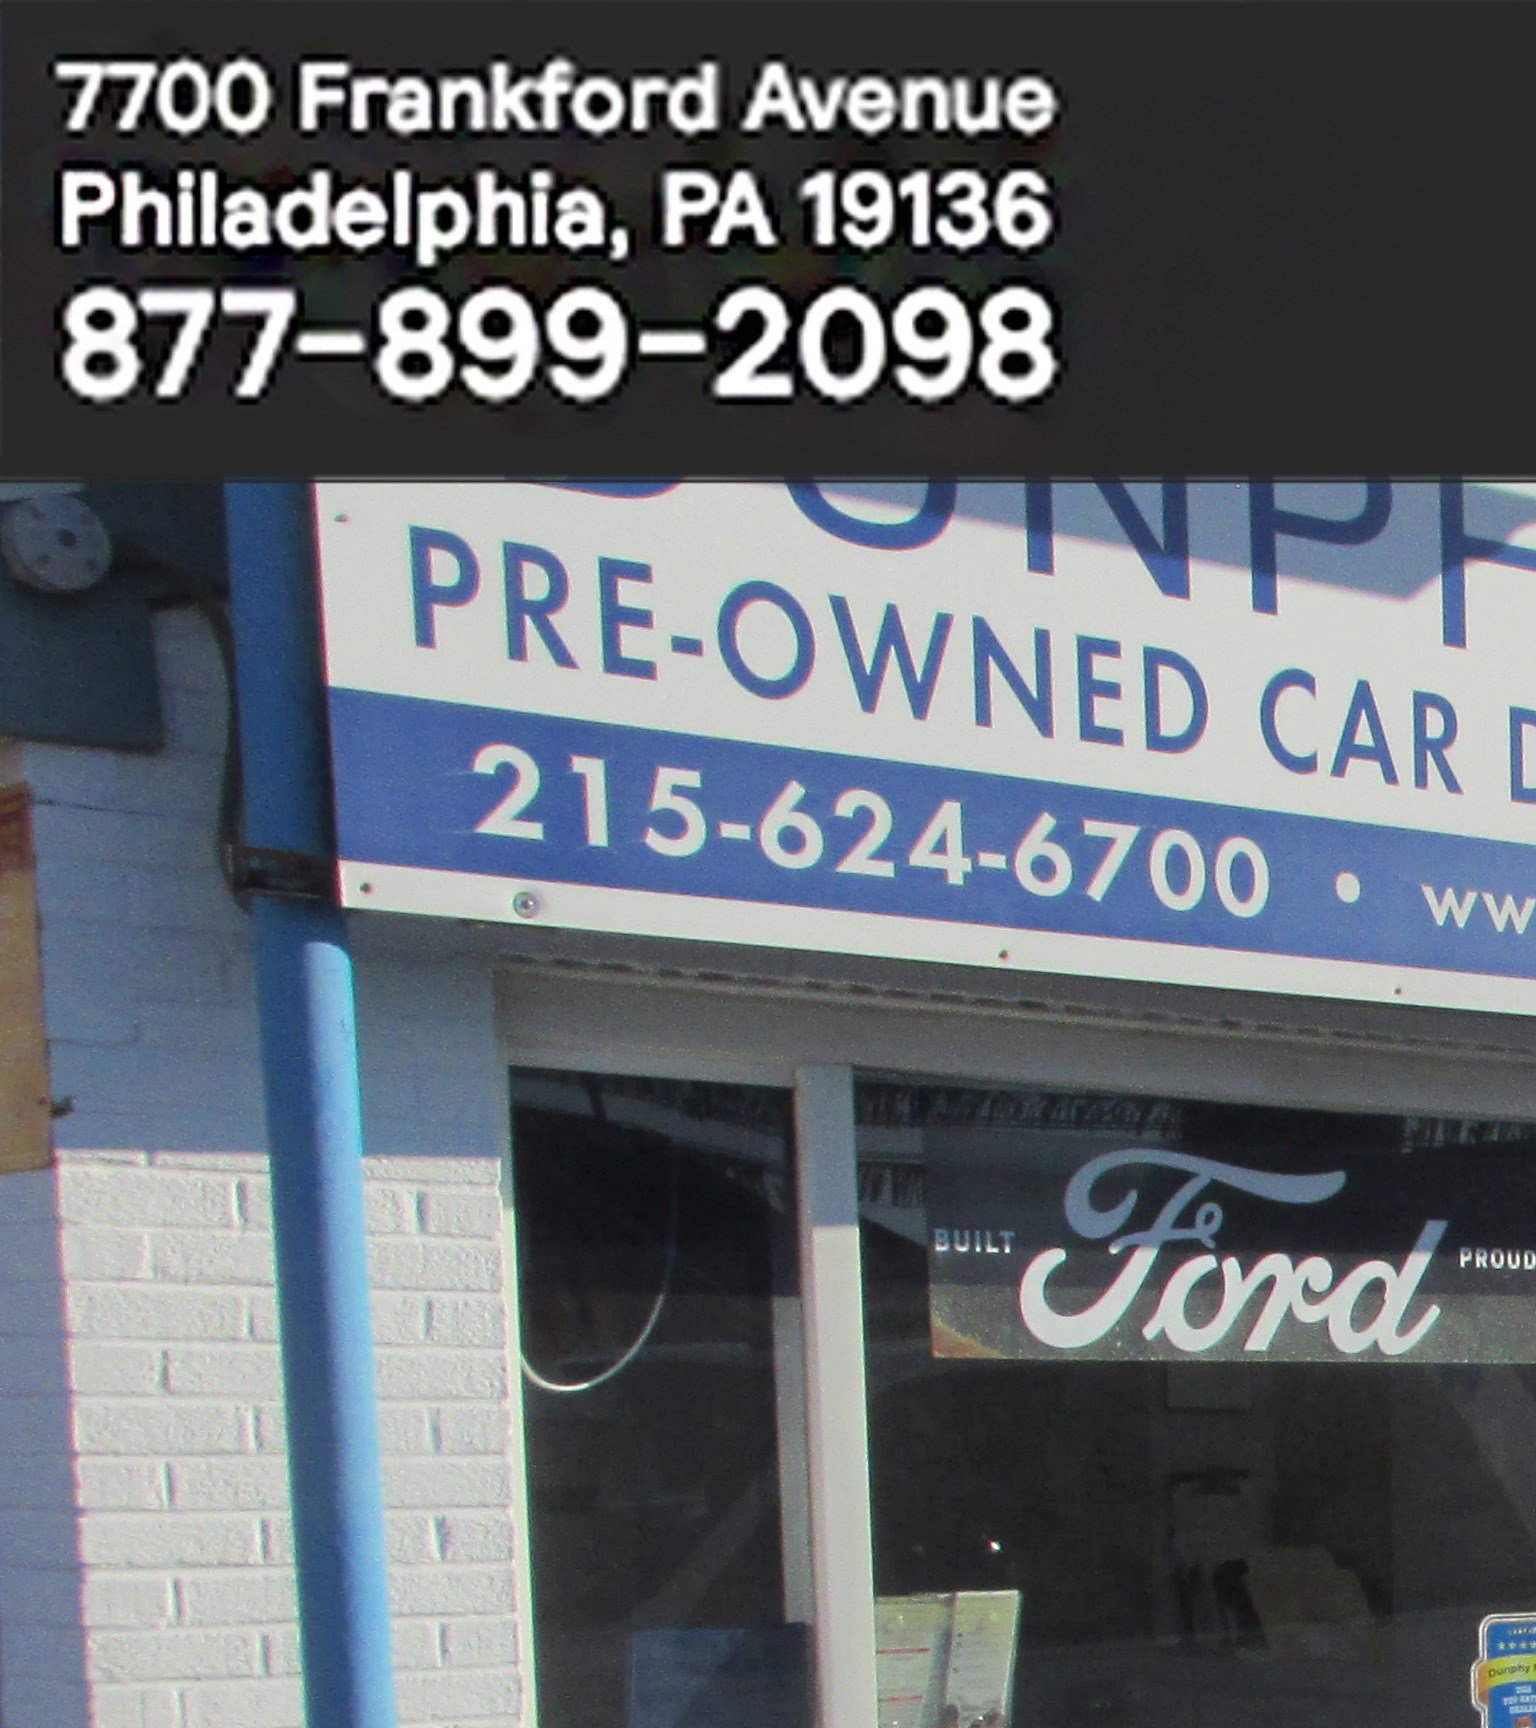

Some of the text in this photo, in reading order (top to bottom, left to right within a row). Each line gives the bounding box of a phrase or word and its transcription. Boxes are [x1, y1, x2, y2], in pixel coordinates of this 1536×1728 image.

[408, 525, 1208, 754] PRE-OWNED
[1260, 668, 1460, 794] CAR
[472, 743, 1271, 919] 215-624-6700
[933, 1228, 1015, 1255] BUILT
[1019, 1147, 1449, 1356] Ford
